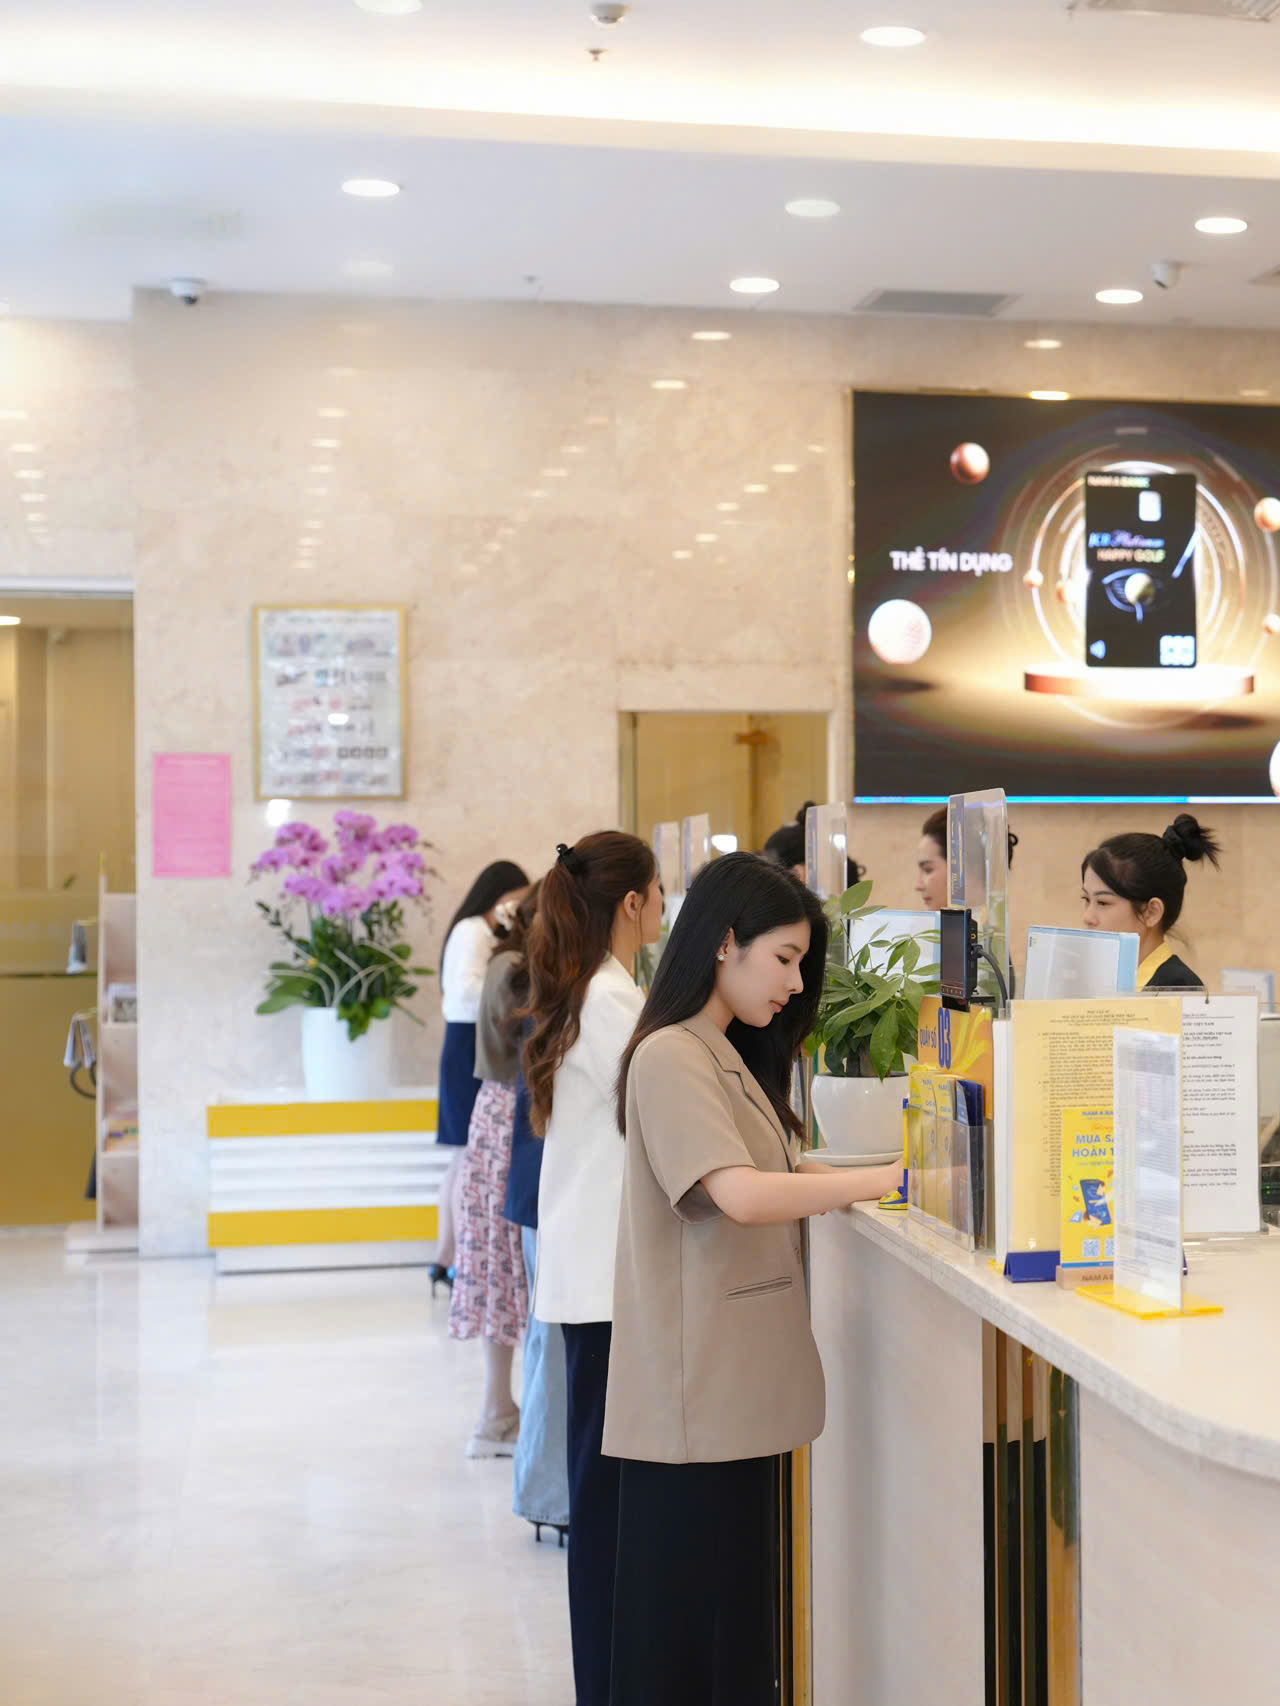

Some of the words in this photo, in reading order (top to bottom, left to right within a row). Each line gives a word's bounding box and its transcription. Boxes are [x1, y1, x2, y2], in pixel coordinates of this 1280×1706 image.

[959, 551, 1013, 577] DỤNG
[938, 1007, 952, 1069] 03
[1076, 1135, 1101, 1144] MUA
